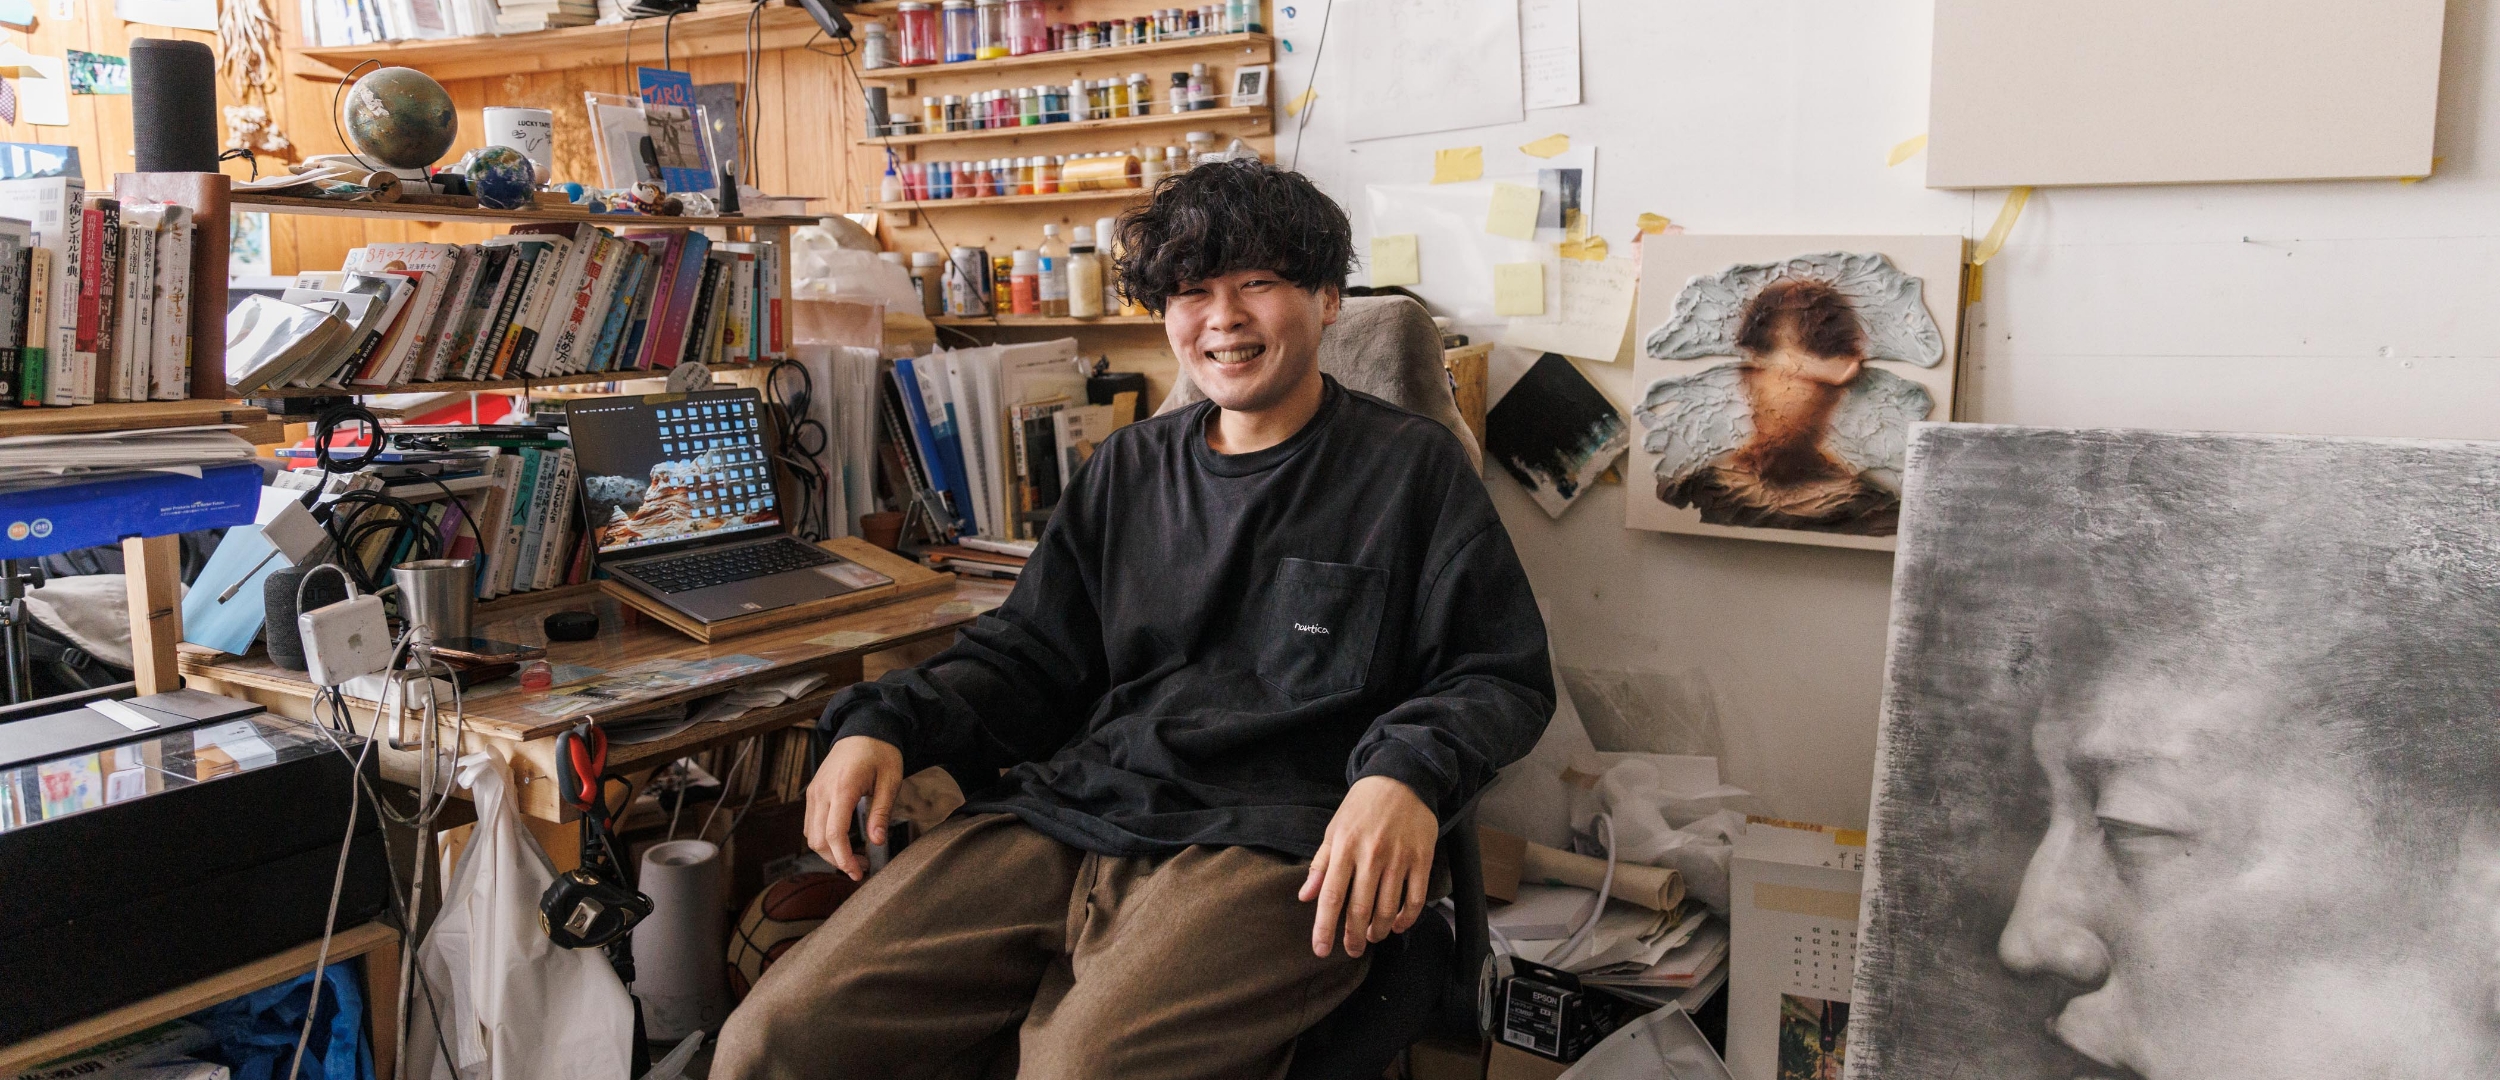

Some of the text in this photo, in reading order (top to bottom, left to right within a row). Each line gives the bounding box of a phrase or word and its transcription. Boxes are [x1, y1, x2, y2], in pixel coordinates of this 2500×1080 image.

[641, 83, 684, 111] TARO
[517, 120, 538, 128] LUCKY
[67, 191, 82, 277] 美術シンボル事典
[84, 214, 97, 296] 消費社会の神話と構造
[367, 247, 442, 262] 3月のライオン
[521, 251, 547, 315] 世界史を変えた新素材
[547, 243, 569, 287] 観察者の系譜
[96, 298, 113, 350] 村上隆
[557, 261, 602, 363] 個人事業の始め方
[534, 454, 551, 509] お金と時間の科学
[538, 456, 559, 531] TIME SMART
[558, 468, 571, 479] AI
[550, 484, 563, 524] 子どもたち
[1294, 622, 1330, 635] nautica
[1532, 991, 1558, 1005] EPSON
